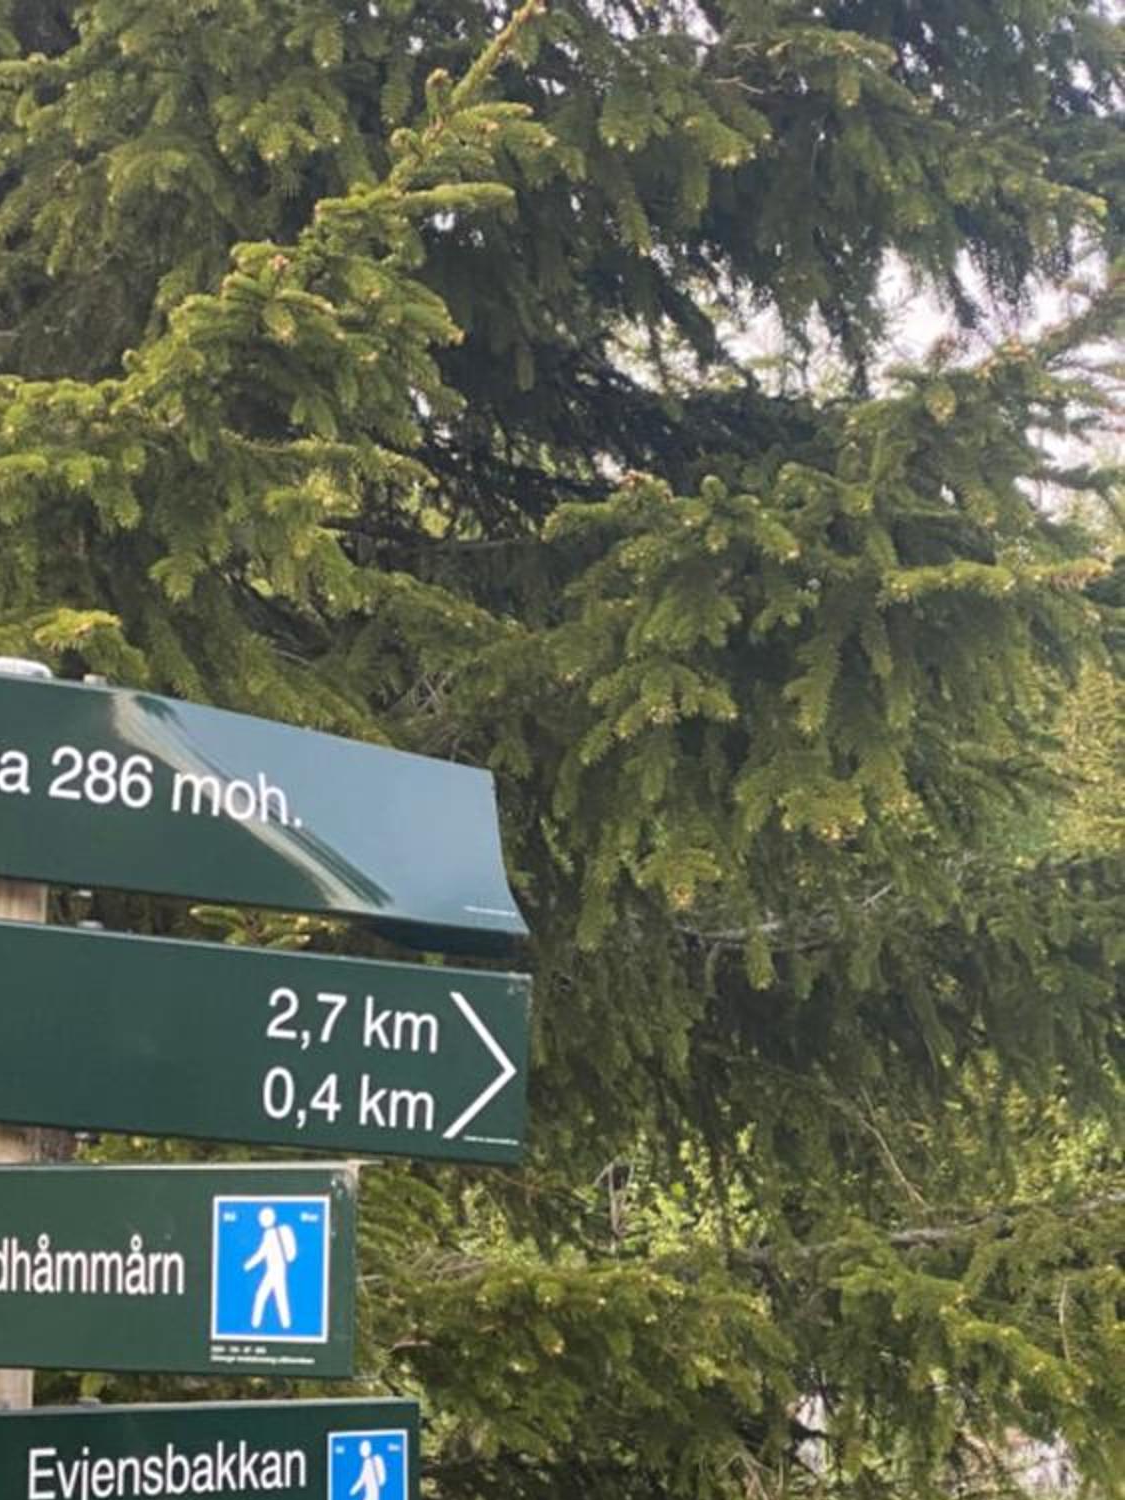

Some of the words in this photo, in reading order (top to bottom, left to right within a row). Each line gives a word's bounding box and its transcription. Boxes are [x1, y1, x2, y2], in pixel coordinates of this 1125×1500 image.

[48, 746, 155, 809] 286
[171, 771, 304, 828] moh.
[266, 987, 347, 1050] 2,7
[363, 995, 438, 1053] km
[263, 1066, 342, 1129] 0,4
[359, 1074, 434, 1131] km
